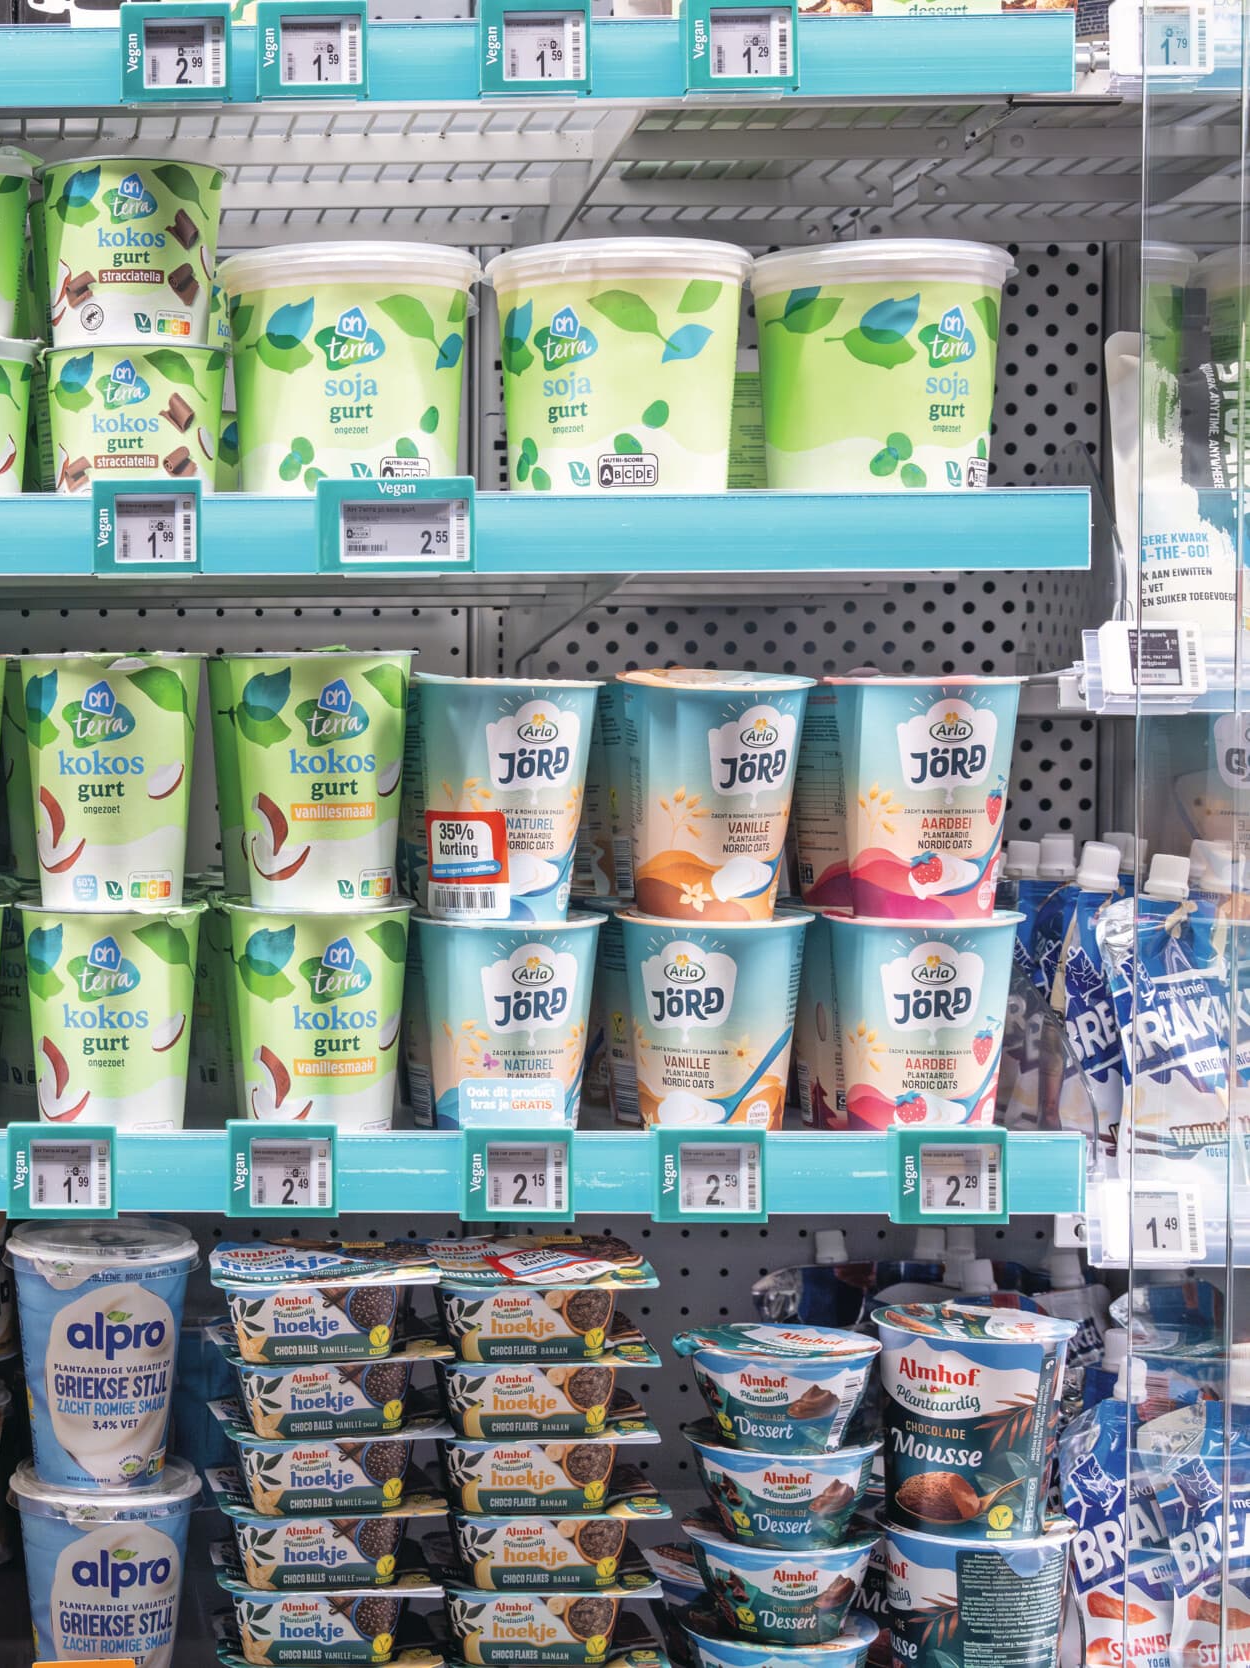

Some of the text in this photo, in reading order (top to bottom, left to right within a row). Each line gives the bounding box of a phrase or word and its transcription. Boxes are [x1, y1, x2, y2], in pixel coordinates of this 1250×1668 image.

[693, 19, 707, 59] Vegan
[126, 33, 140, 72] Vegan
[110, 199, 153, 218] terra
[98, 228, 165, 248] kokos
[113, 251, 150, 267] gurt
[102, 270, 161, 282] stracciatella
[325, 338, 379, 361] terra
[324, 373, 378, 402] soja
[330, 403, 373, 422] gurt
[334, 425, 368, 435] ongezoet
[378, 481, 416, 496] Vegan
[1171, 533, 1208, 544] KWARK
[1152, 567, 1212, 579] AAN EIWITTEN
[1149, 583, 1163, 593] VET
[1157, 593, 1187, 605] SUIKER
[525, 724, 552, 738] Arla
[936, 725, 966, 736] Arla
[59, 750, 144, 775] kokos
[289, 748, 376, 774] kokos
[78, 780, 124, 802] gurt
[311, 780, 358, 800] gurt
[83, 804, 120, 815] ongezoet
[295, 805, 373, 819] vanillesmaak
[506, 818, 554, 830] NATUREL
[728, 822, 769, 834] VANILLE
[921, 818, 971, 829] AARDBEI
[534, 841, 554, 849] OATS
[918, 840, 972, 848] NORDIC OATS
[467, 1086, 555, 1098] Ook dit product
[471, 1100, 552, 1112] kras je GRATIS
[470, 1154, 484, 1192] Vegan
[904, 1155, 918, 1196] Vegan
[274, 1296, 313, 1307] Almhof
[493, 1298, 531, 1308] Almhof
[273, 1317, 340, 1337] hoekje
[490, 1317, 555, 1337] hoekje
[67, 1312, 165, 1360] alpro
[274, 1344, 348, 1355] CHOCO BALLS VANILLE
[490, 1345, 568, 1355] CHOCO FLAKES BANAAN
[899, 1357, 981, 1387] Almhof
[55, 1373, 166, 1399] GRIEKSE STIJL
[740, 1373, 788, 1388] Almhof
[896, 1384, 981, 1412] Plantaardig
[56, 1399, 135, 1416] ZACHT ROMIGE
[92, 1419, 138, 1430] 3,4% VET
[734, 1416, 793, 1439] Dessert
[905, 1420, 965, 1440] CHOCOLADE
[891, 1428, 983, 1467] Mousse
